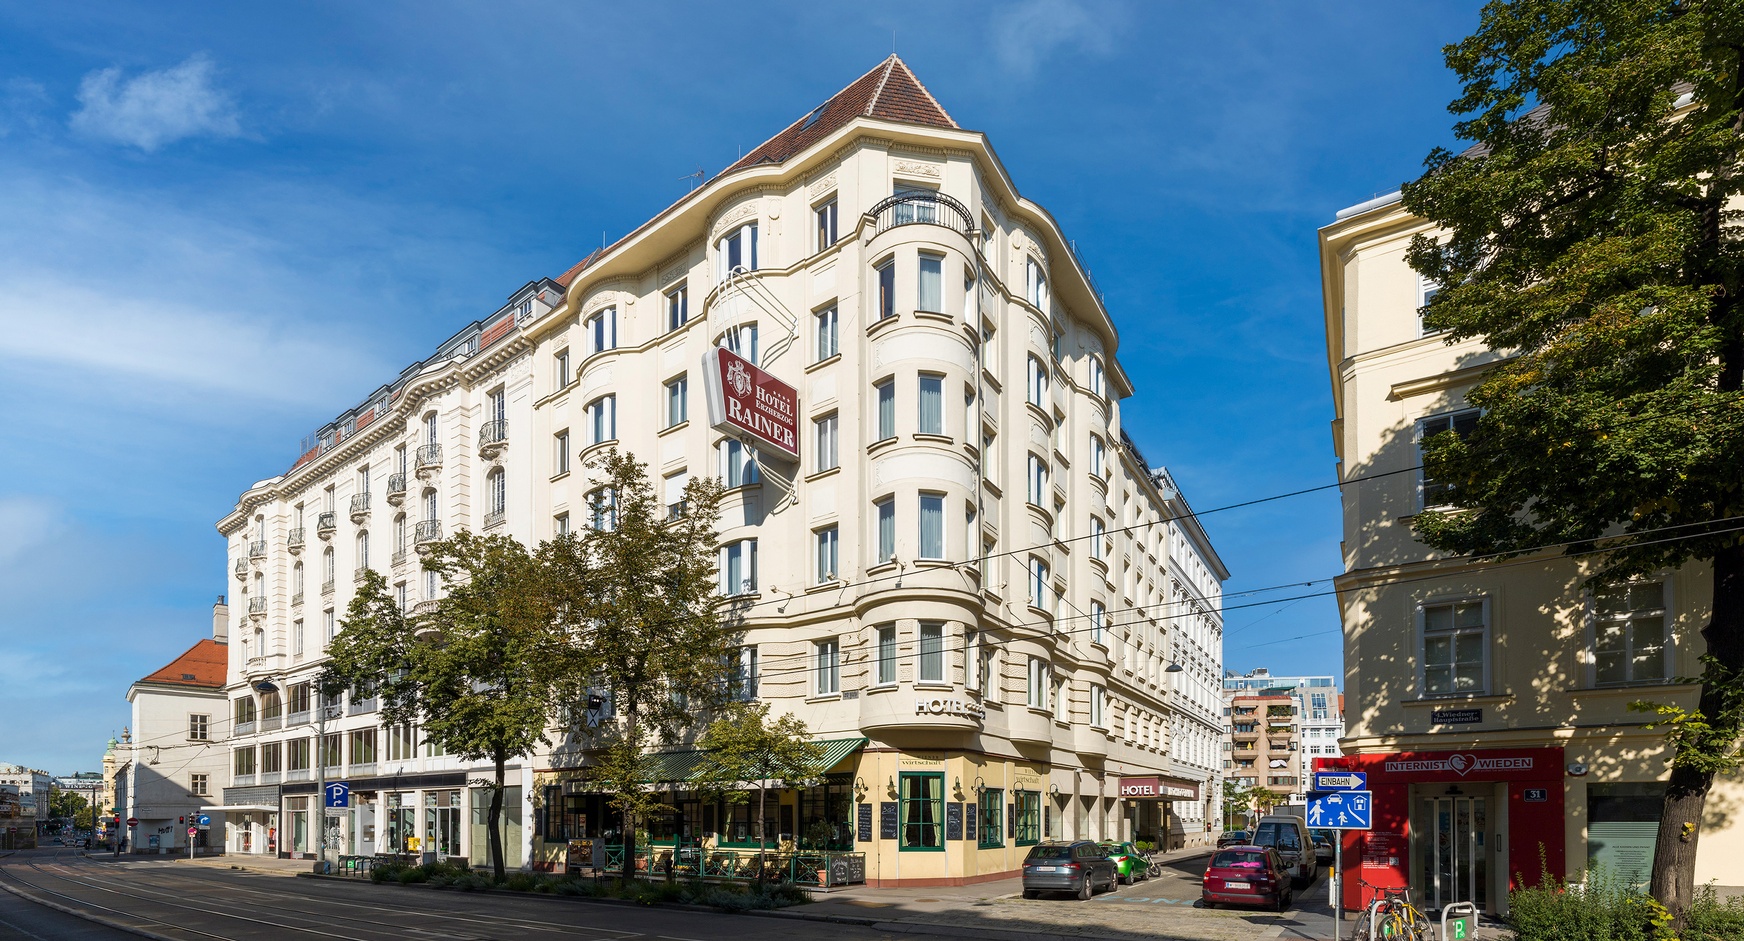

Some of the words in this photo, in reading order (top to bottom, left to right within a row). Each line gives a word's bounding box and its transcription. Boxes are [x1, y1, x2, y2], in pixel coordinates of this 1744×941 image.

[756, 385, 793, 416] HOTEL
[756, 399, 793, 425] ERZHERZOG
[728, 396, 795, 448] RAINER
[915, 698, 968, 714] HOTEL
[1433, 715, 1479, 723] Hauptstraße
[1386, 761, 1446, 771] INTERNIST
[1479, 758, 1531, 768] WIEDEN
[1321, 777, 1351, 785] EINBAHN
[333, 787, 344, 799] P
[1121, 785, 1155, 795] HOTEL
[1530, 790, 1541, 798] 31
[1455, 921, 1463, 938] P
